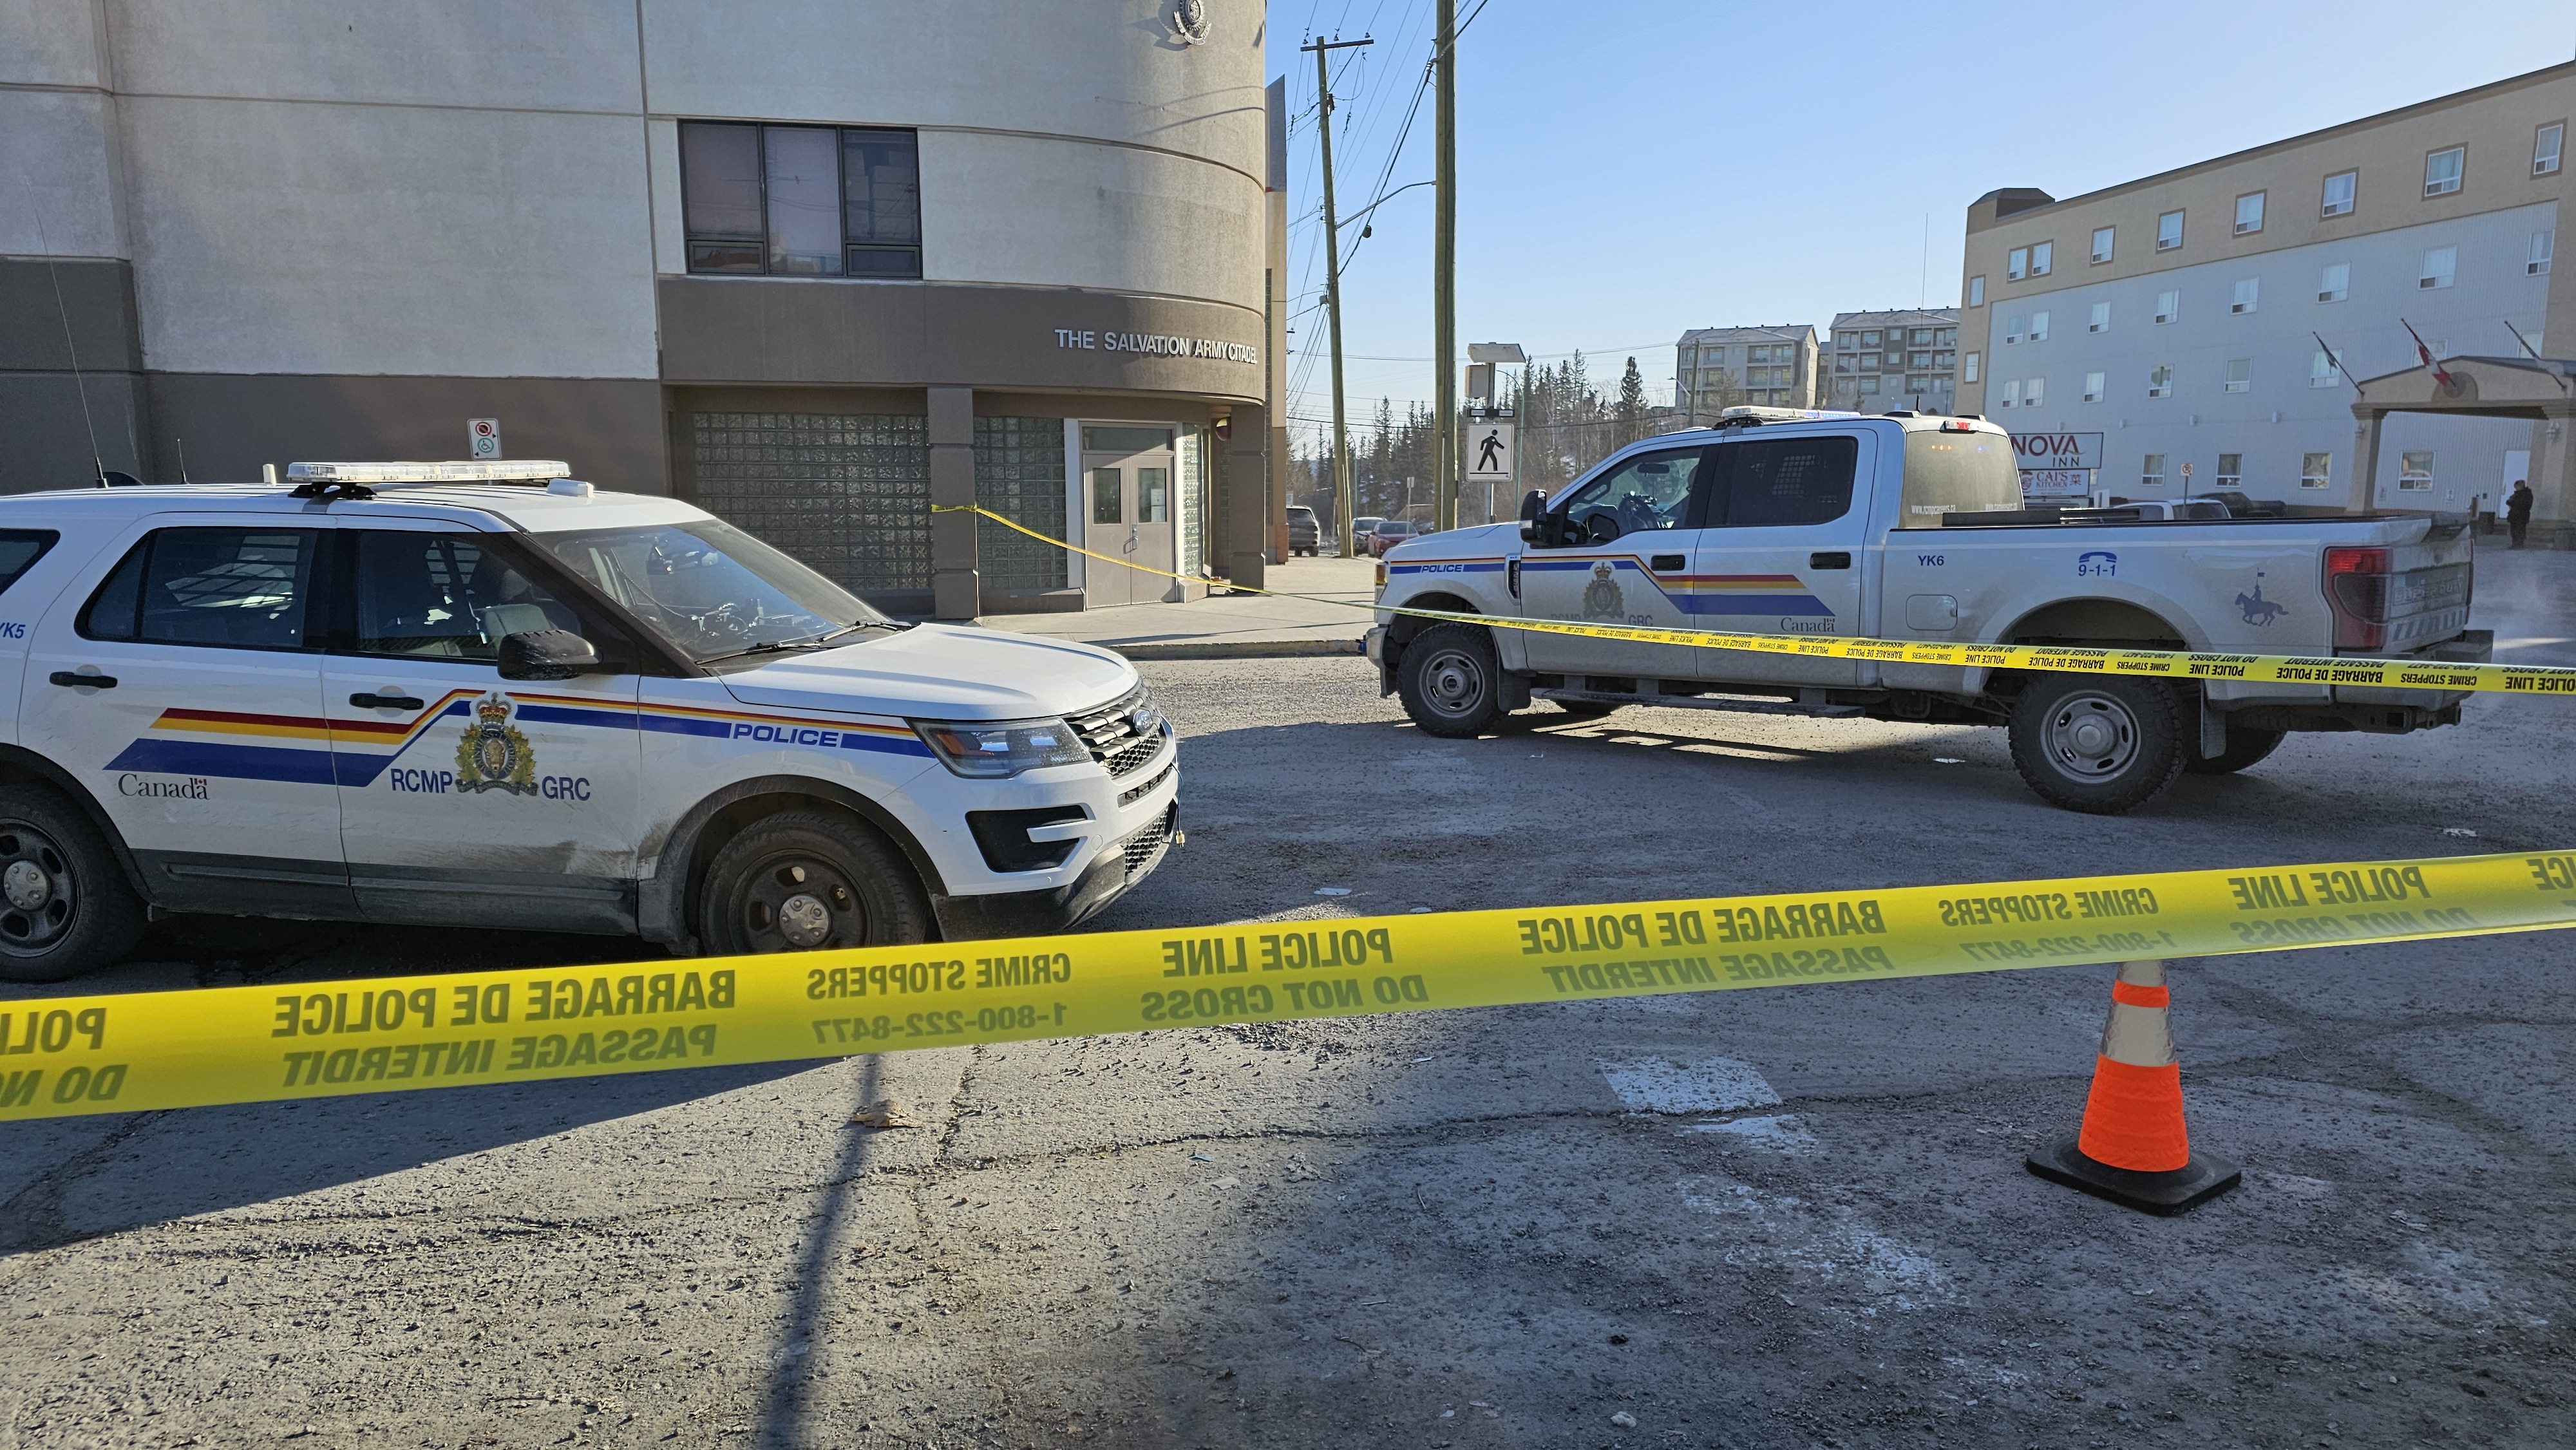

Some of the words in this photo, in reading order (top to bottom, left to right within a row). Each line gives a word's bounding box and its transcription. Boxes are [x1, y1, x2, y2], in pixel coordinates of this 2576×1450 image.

[1054, 329, 1095, 350] THE
[1104, 331, 1189, 356] SALVATION
[1195, 339, 1227, 359] ARMY
[1227, 343, 1257, 364] CITADEL
[2011, 435, 2079, 457] NOVA
[2052, 457, 2079, 467] INN
[2036, 471, 2068, 482] CAI'S
[1918, 555, 1944, 567] YK6
[1421, 564, 1463, 573] POLICE
[2078, 563, 2116, 577] 9-1-1
[1629, 615, 1653, 626] GRC
[1781, 617, 1835, 632] Canada
[1680, 636, 1694, 644] POLICE
[1706, 637, 1721, 646] POLICE
[1722, 639, 1728, 647] DE
[1729, 639, 1752, 649] BARRAGE
[1798, 645, 1810, 654] LINE
[1811, 645, 1830, 655] POLICE
[1846, 648, 1866, 657] POLICE
[1866, 648, 1875, 658] DE
[1875, 650, 1903, 659] BARRAGE
[1912, 652, 1935, 660] STOPPERS
[1965, 654, 1980, 663] LINE
[1982, 654, 2006, 664] POLICE
[2188, 654, 2219, 662] CROSS
[2221, 654, 2240, 663] NOT
[2028, 657, 2054, 667] POLICE
[2055, 658, 2066, 668] DE
[2067, 659, 2105, 670] BARRAGE
[2116, 661, 2148, 671] STOPPERS
[2285, 657, 2331, 666] INTERDIT
[2333, 659, 2387, 668] PASSAGE
[2149, 663, 2170, 672] CRIME
[2189, 664, 2210, 675] LINE
[2211, 664, 2244, 677] POLICE
[2277, 668, 2312, 680] POLICE
[2315, 669, 2329, 681] DE
[2331, 670, 2383, 683] BARRAGE
[2401, 673, 2445, 684] STOPPERS
[2448, 675, 2477, 686] CRIME
[2505, 676, 2534, 690] LINE
[2538, 677, 2576, 693] OLICE
[733, 724, 838, 747] POLICE
[391, 768, 453, 794] RCMP
[118, 775, 209, 800] Canada
[542, 776, 591, 801] GRC
